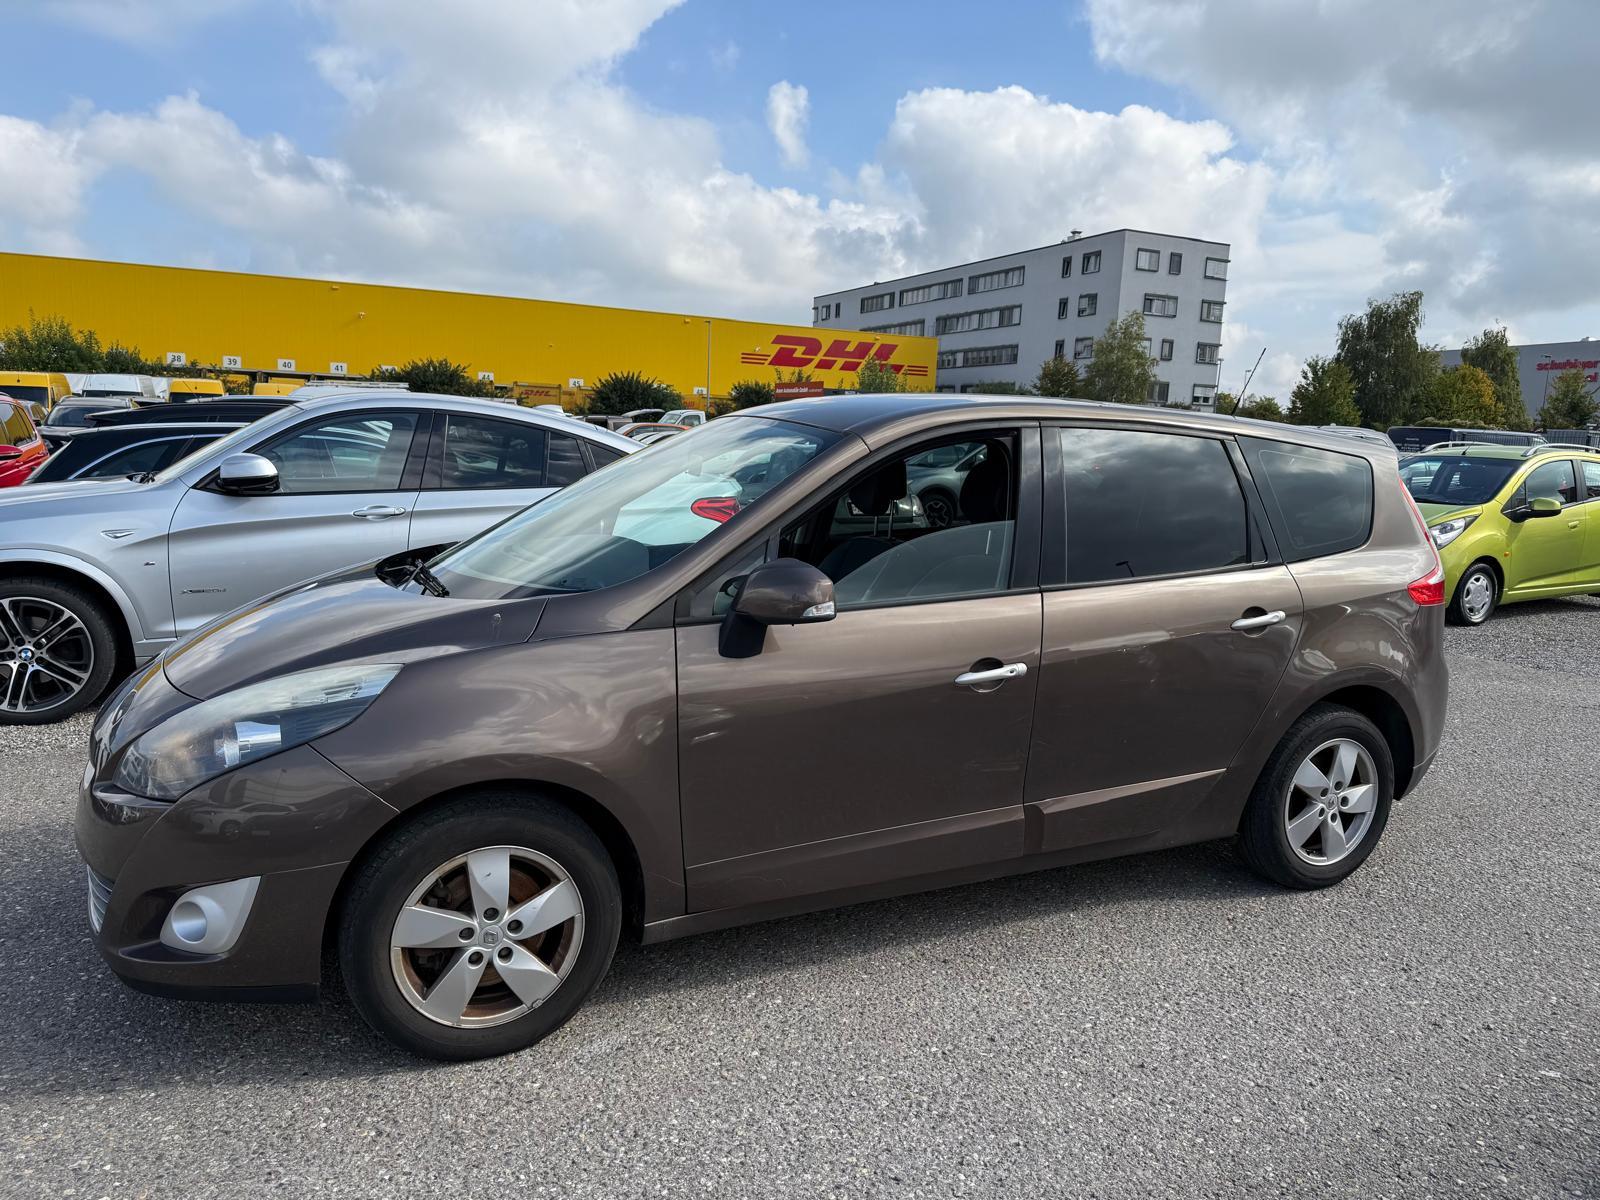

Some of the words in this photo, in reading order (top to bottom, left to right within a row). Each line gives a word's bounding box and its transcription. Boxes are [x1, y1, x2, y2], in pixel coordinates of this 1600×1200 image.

[171, 355, 182, 363] 38
[768, 335, 905, 375] DHL
[227, 358, 238, 366] 39
[282, 361, 292, 369] 40
